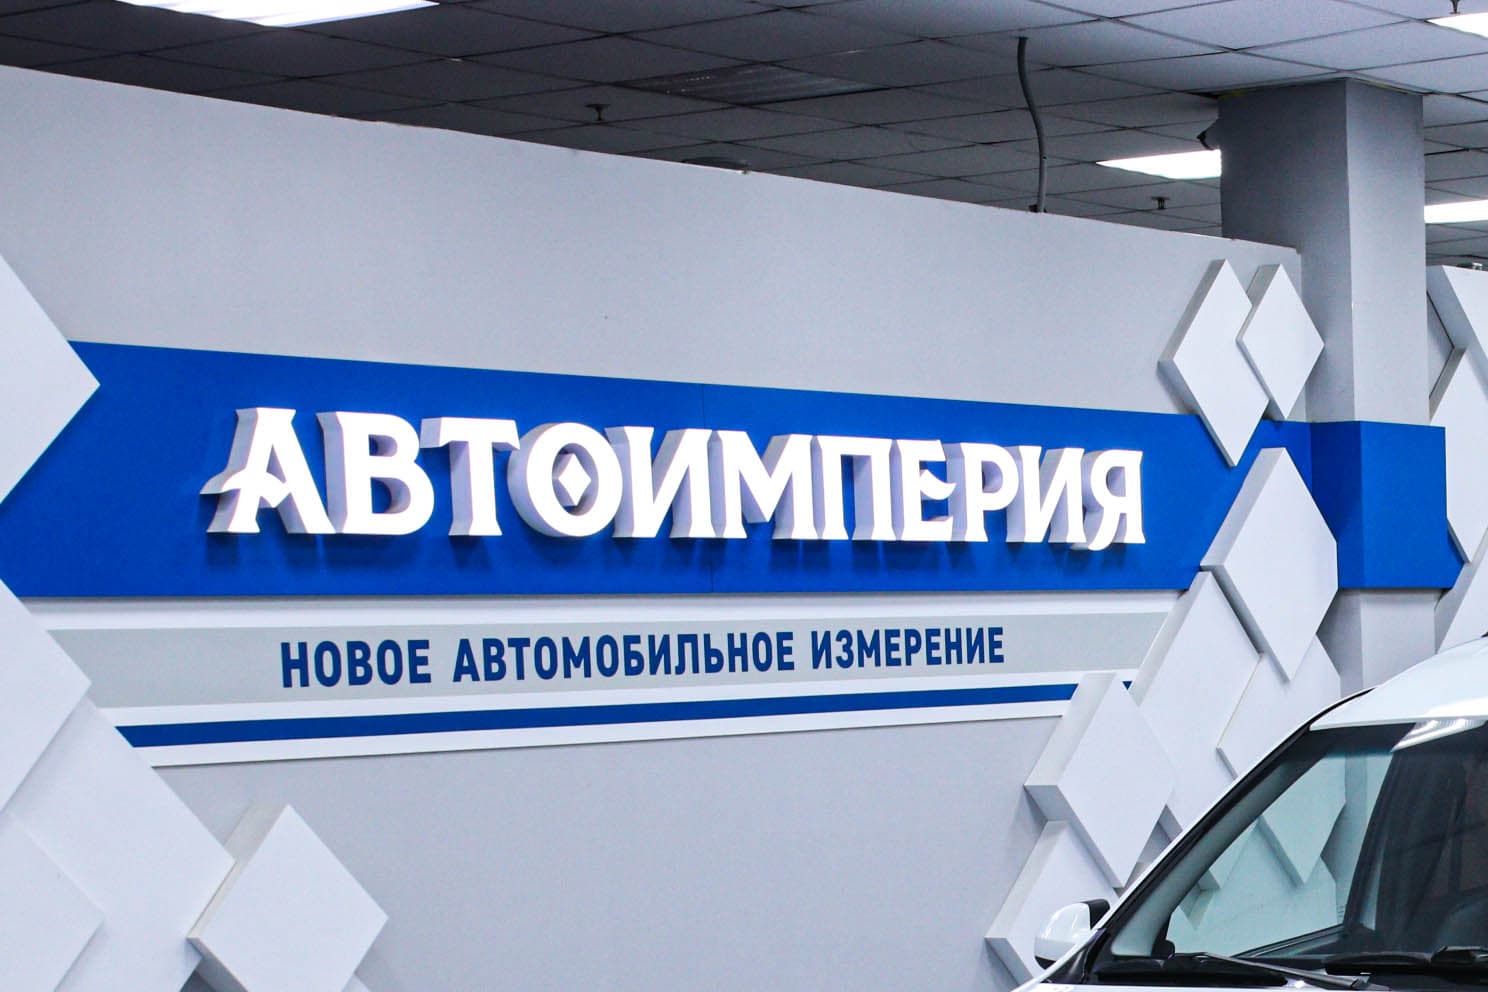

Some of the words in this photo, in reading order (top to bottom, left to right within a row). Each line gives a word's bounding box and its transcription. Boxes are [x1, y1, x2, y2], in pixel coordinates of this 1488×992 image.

[200, 408, 1147, 552] АВТОИМПЕРИЯ
[281, 639, 432, 689] НОВОЕ
[452, 631, 796, 684] АВТОМОБИЛЬНОЕ
[811, 626, 1006, 670] ИЗМЕРЕНИЕ
